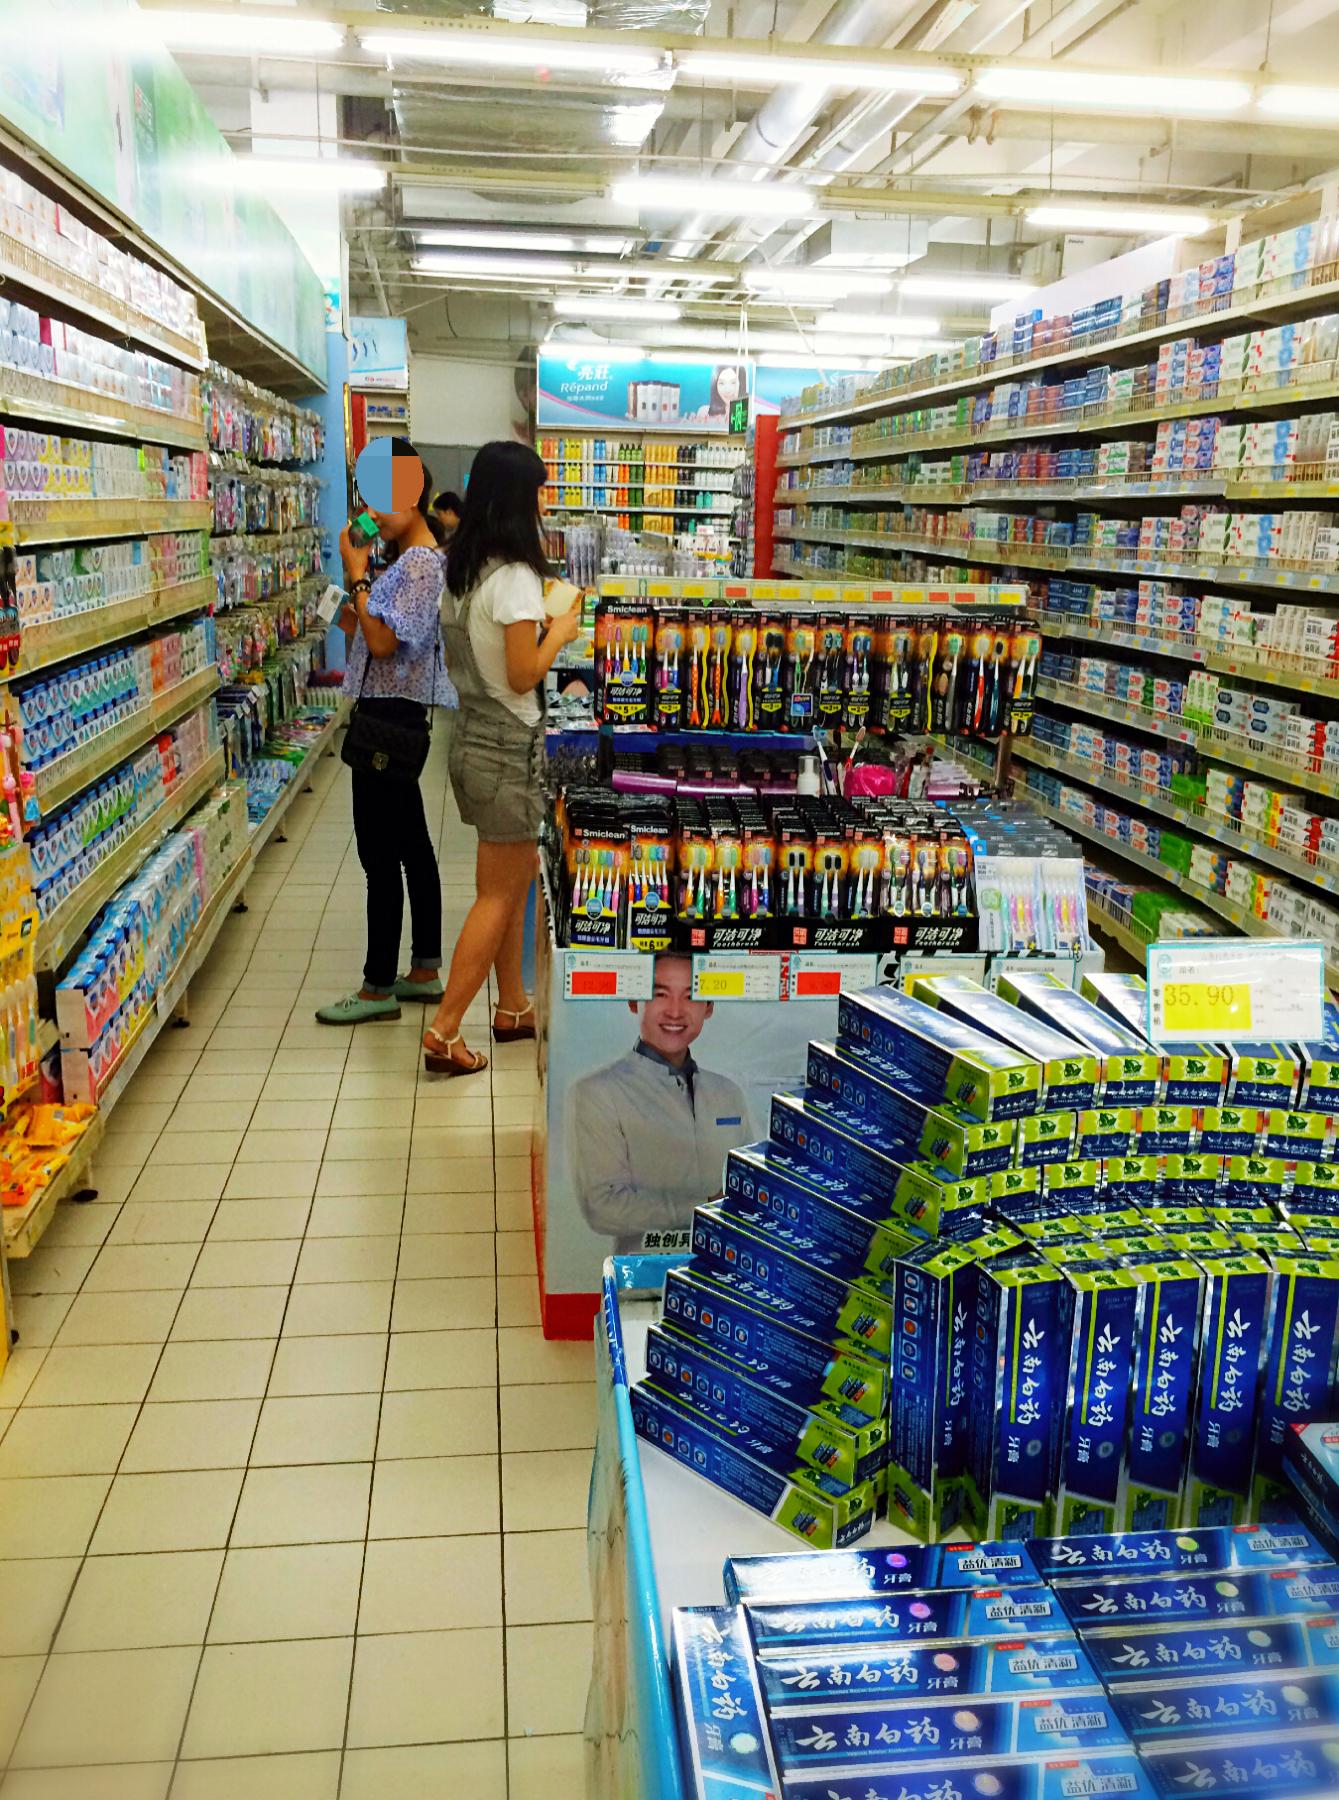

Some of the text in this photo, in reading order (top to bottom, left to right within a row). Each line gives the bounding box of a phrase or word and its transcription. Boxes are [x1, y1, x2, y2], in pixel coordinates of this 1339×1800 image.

[561, 381, 608, 394] Répand
[607, 605, 647, 614] Smiclean
[583, 829, 625, 840] Smiclean
[631, 824, 668, 834] Smiclean
[574, 921, 610, 934] 可洁可净
[634, 914, 667, 926] 可洁可净
[915, 926, 964, 940] 可洁可净
[712, 940, 759, 948] Toothbrush
[713, 928, 762, 941] 可洁可净
[814, 928, 864, 941] 可洁可净
[1016, 1318, 1046, 1425] 云南白药
[1150, 1314, 1184, 1416] 云南白药
[1218, 1308, 1251, 1412] 云南白药
[1282, 1310, 1321, 1412] 云南白药
[1088, 1322, 1121, 1427] 云南白药
[1140, 1425, 1154, 1452] 牙膏
[1206, 1420, 1221, 1449] 牙膏
[1007, 1434, 1021, 1464] 牙膏
[1078, 1436, 1092, 1464] 牙膏
[1051, 1540, 1173, 1566] 云南白药
[1180, 1553, 1208, 1565] 牙膏
[882, 1572, 912, 1584] 牙膏
[1081, 1586, 1207, 1614] 云南白药
[1217, 1600, 1246, 1613] 牙膏
[770, 1604, 900, 1632] 云南白药
[907, 1621, 938, 1634] 牙膏
[1111, 1636, 1243, 1668] 云南白药
[1252, 1651, 1283, 1664] 牙膏
[700, 1616, 748, 1720] 云南白药
[780, 1659, 919, 1690] 云南白药
[926, 1675, 959, 1690] 牙膏
[1141, 1690, 1278, 1725] 云南白药
[1288, 1707, 1320, 1721] 牙膏
[702, 1722, 724, 1752] 牙膏
[795, 1716, 941, 1751] 云南白药
[948, 1736, 983, 1750] 牙膏
[1176, 1748, 1316, 1789] 云南白药
